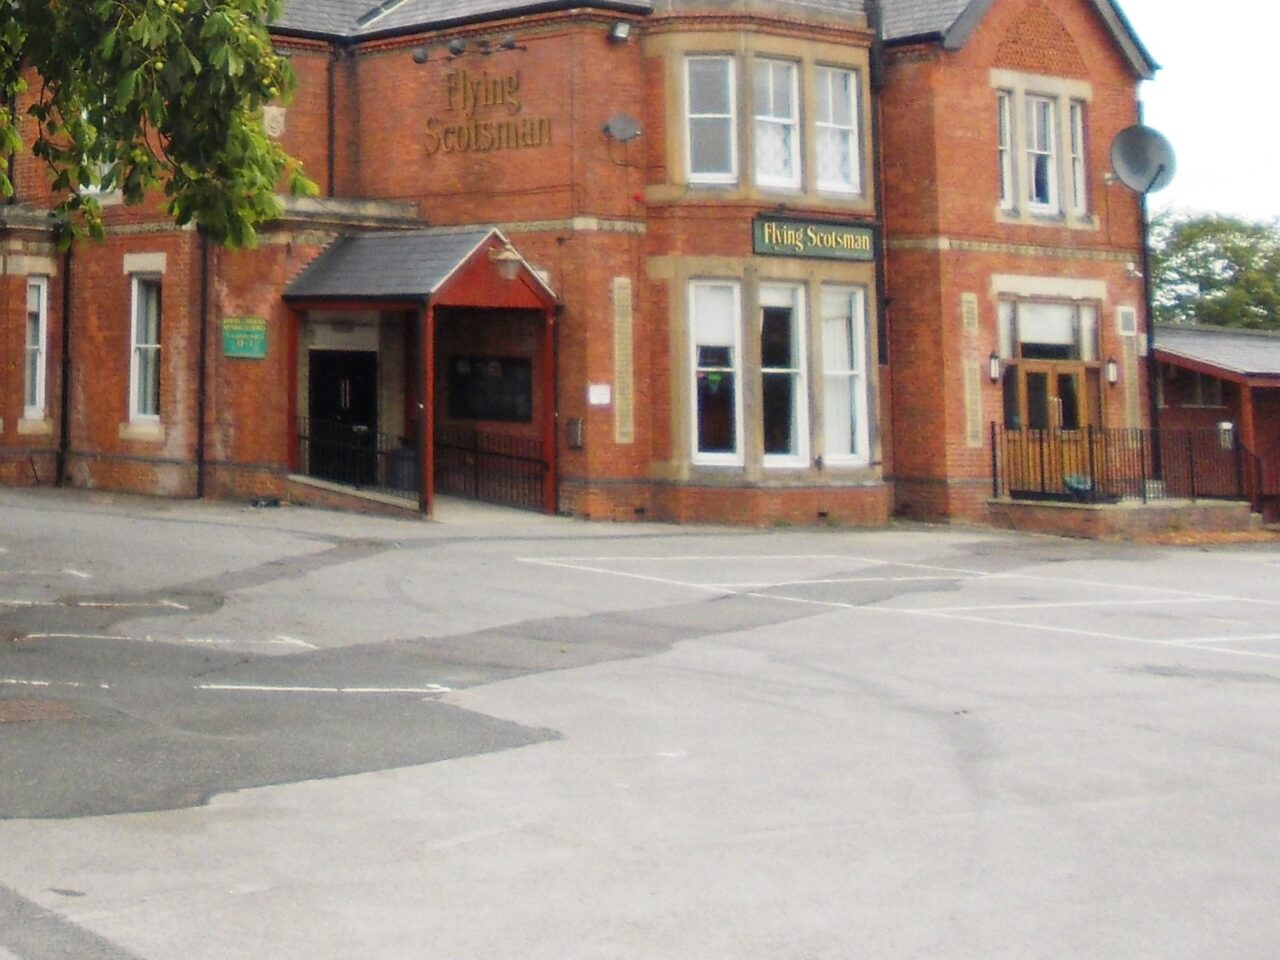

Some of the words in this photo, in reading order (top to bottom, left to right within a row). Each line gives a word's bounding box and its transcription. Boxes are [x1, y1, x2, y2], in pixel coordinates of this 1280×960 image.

[445, 69, 522, 116] Flying
[424, 117, 552, 156] Scotsman
[764, 222, 804, 251] Flying
[806, 225, 870, 250] Scotsman
